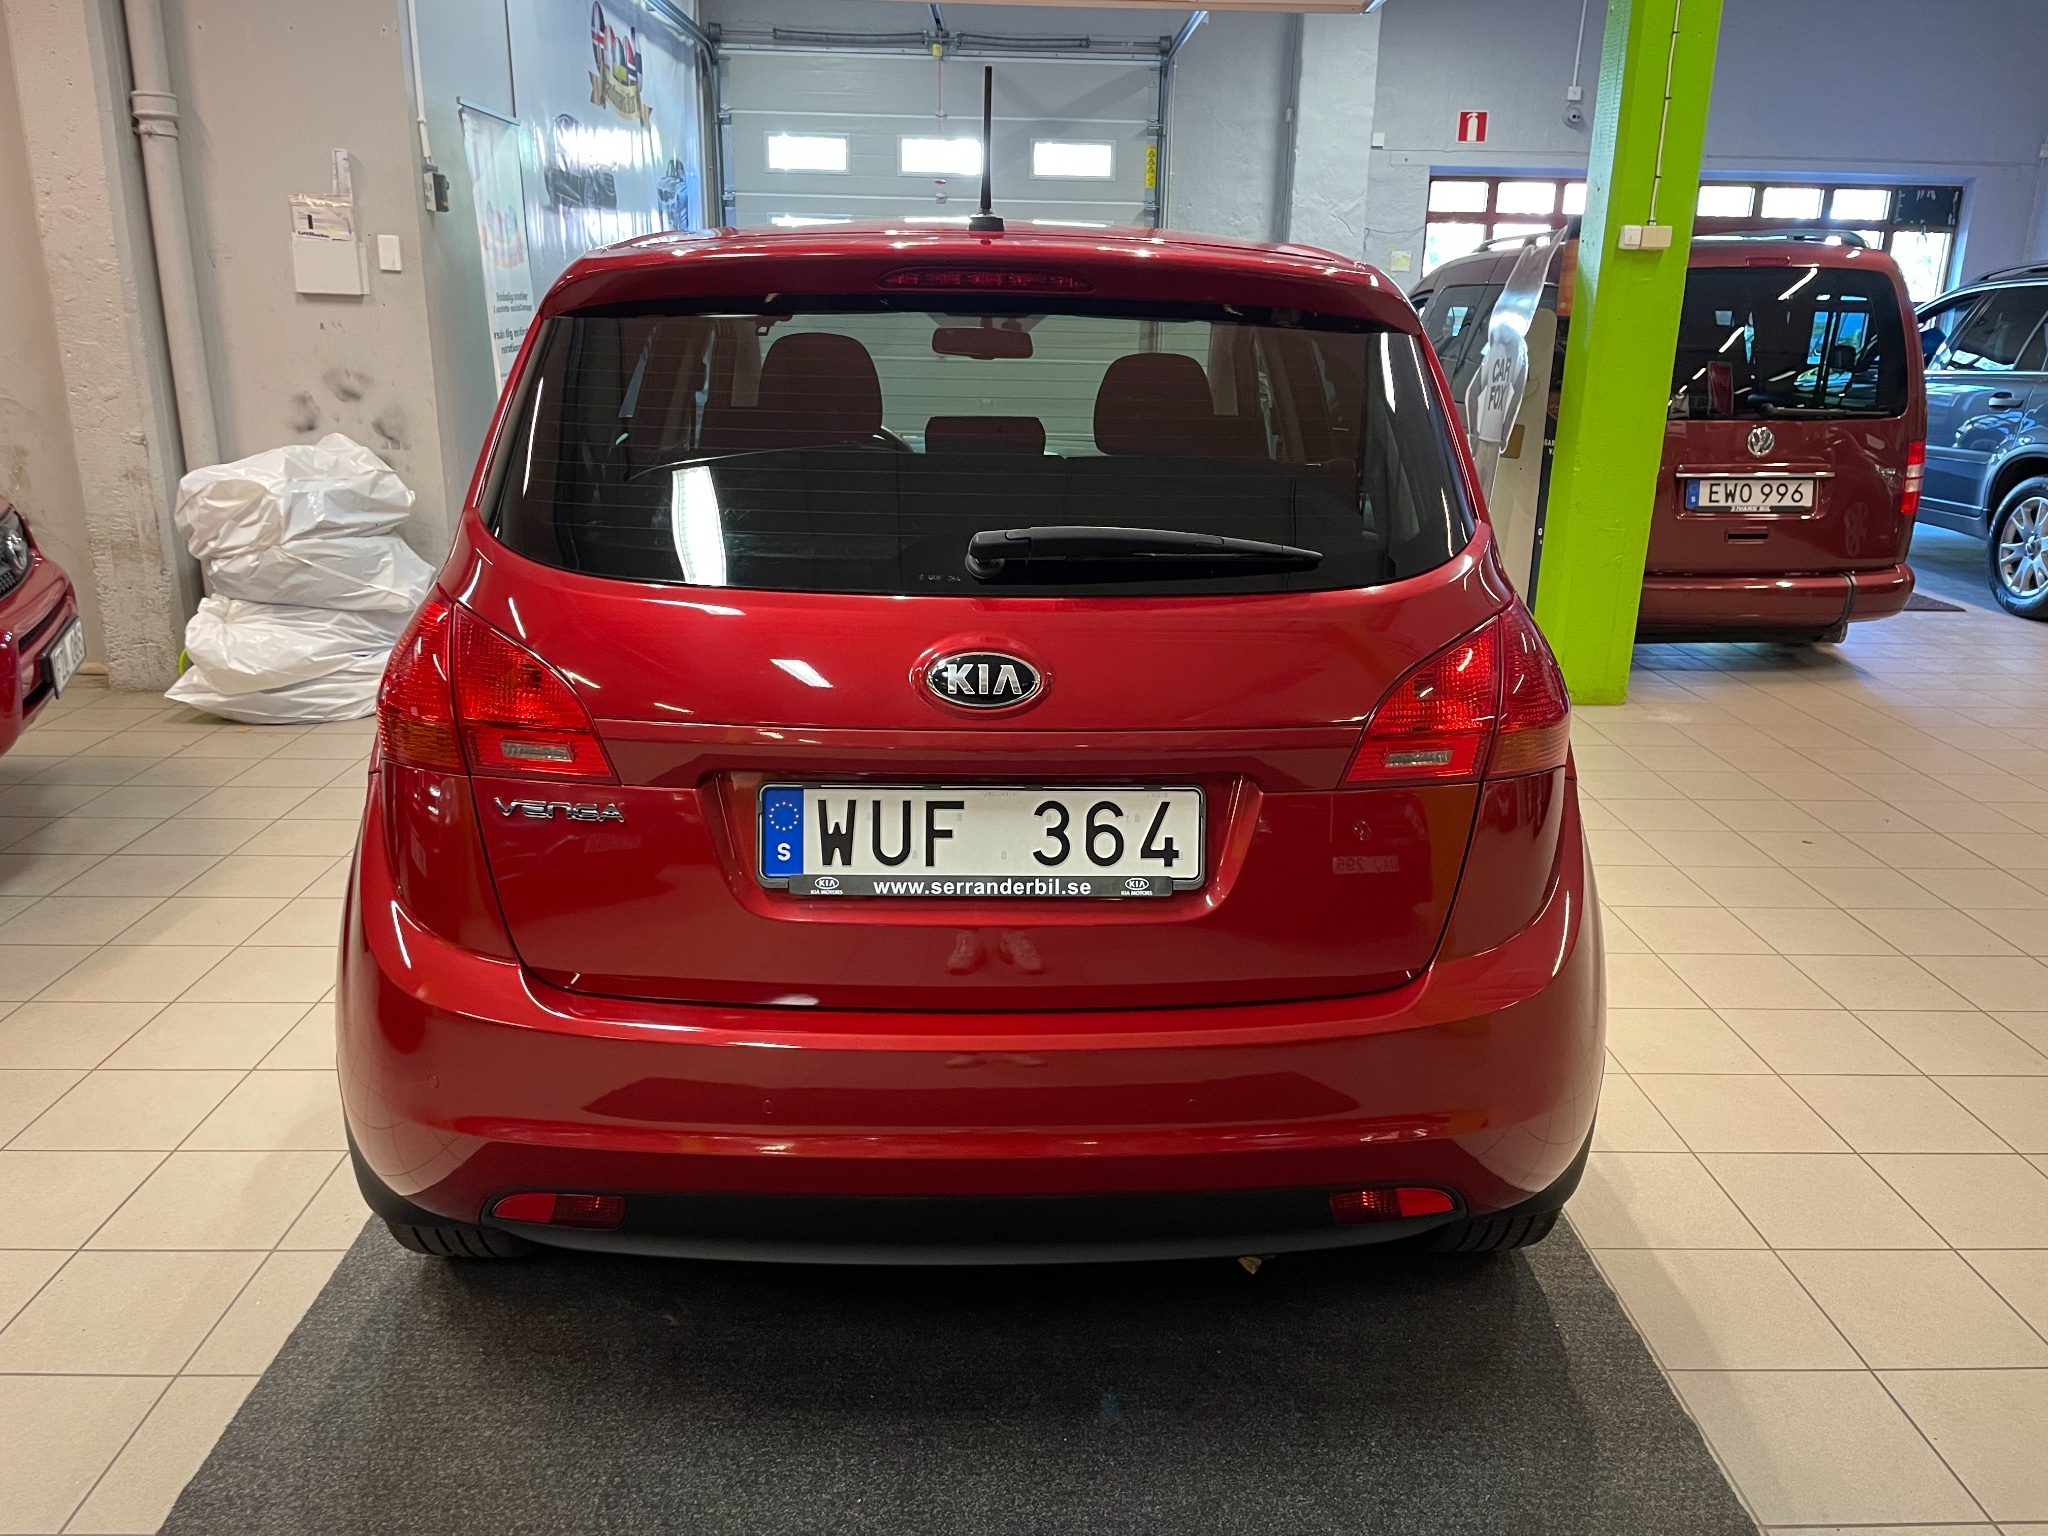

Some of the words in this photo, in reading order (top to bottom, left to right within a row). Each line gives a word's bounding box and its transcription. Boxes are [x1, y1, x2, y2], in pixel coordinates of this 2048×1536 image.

[1493, 357, 1512, 383] CAR
[1488, 384, 1507, 411] FOX
[1708, 483, 1752, 503] EWO
[1760, 483, 1803, 503] 996
[947, 663, 1022, 695] KIA
[494, 796, 626, 823] VENGA
[817, 798, 965, 867] WUF
[1032, 800, 1180, 868] 364
[777, 843, 792, 861] S
[818, 879, 836, 887] KIA
[873, 878, 1092, 896] www.serranderbil.se
[1128, 880, 1145, 888] KIA
